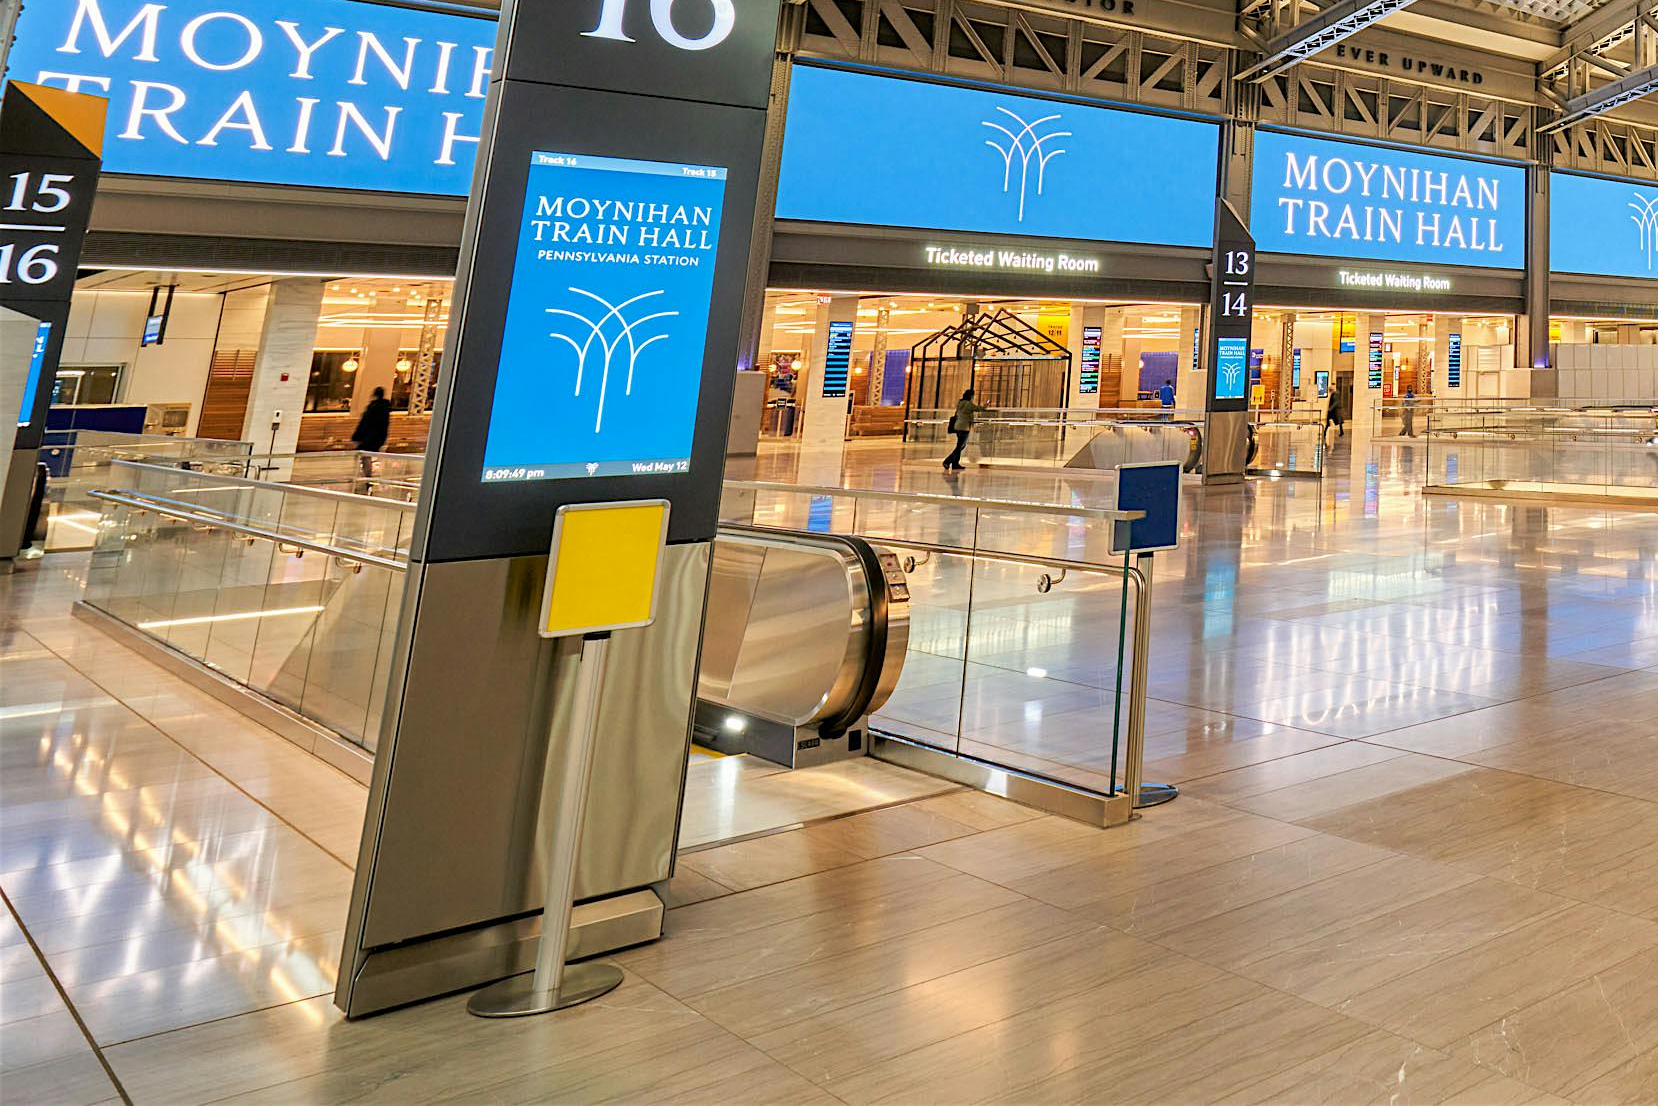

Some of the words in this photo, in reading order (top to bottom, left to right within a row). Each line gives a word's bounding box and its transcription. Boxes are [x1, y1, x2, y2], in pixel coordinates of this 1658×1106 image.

[1336, 44, 1389, 66] EVER
[1402, 57, 1483, 85] UPWARD
[538, 154, 564, 166] Track
[566, 156, 577, 166] 16
[682, 167, 705, 177] Track
[3, 172, 75, 213] 15
[1282, 152, 1499, 211] MOYNIHAN
[535, 195, 713, 226] MOYNIHAN
[531, 220, 628, 245] TRAIN
[638, 227, 712, 250] HALL
[1278, 197, 1404, 244] TRAIN
[1416, 211, 1504, 252] HALL
[0, 244, 60, 285] 16
[538, 249, 640, 265] PENNSYLVANIA
[643, 254, 700, 267] STATION
[925, 247, 993, 266] Ticketed
[998, 250, 1054, 271] Waiting
[1058, 254, 1099, 272] Room
[1225, 251, 1249, 275] 13
[1339, 271, 1383, 287] Ticketed
[1385, 274, 1422, 291] Waiting
[1423, 277, 1450, 291] Room
[1222, 292, 1247, 317] 14
[485, 468, 526, 479] 8:09:49
[527, 469, 544, 480] pm
[632, 462, 653, 472] Wed
[655, 461, 675, 473] May
[676, 461, 687, 471] 12
